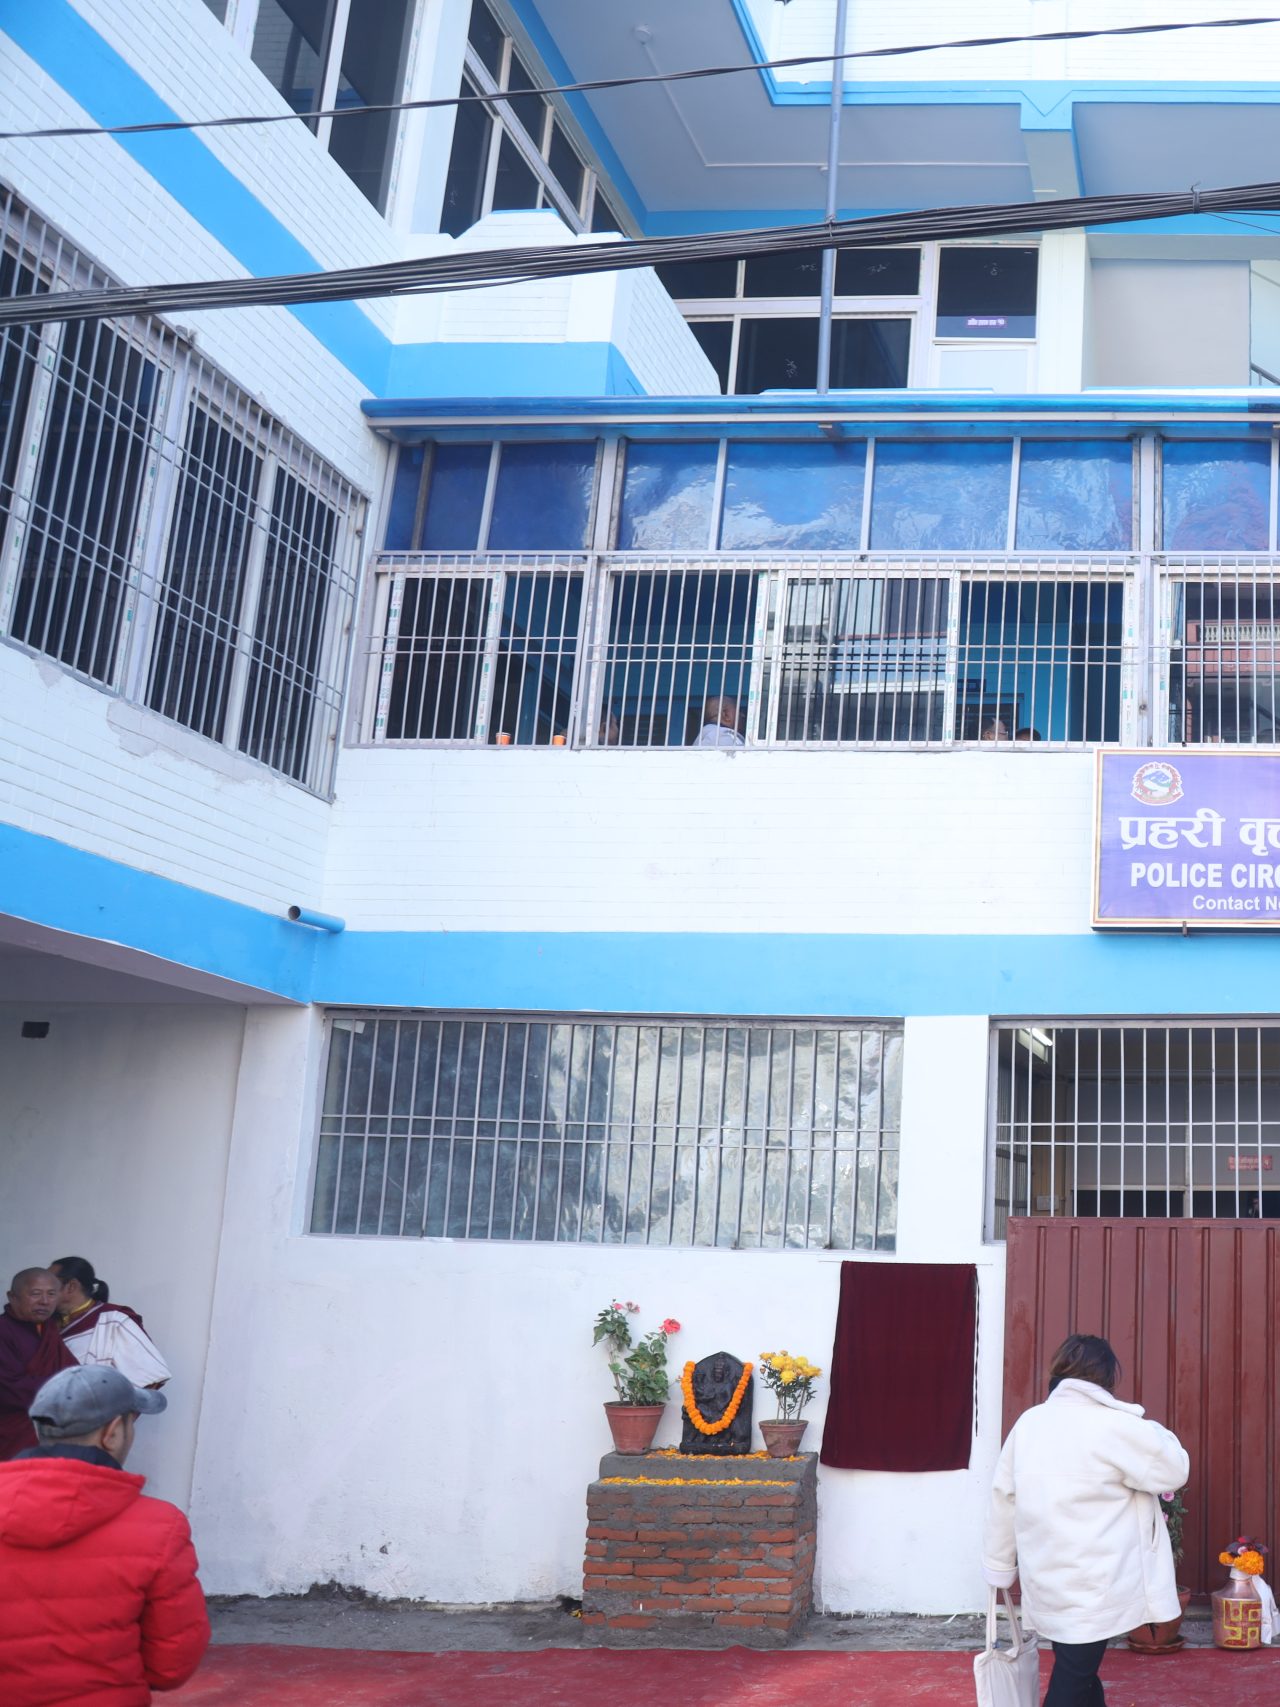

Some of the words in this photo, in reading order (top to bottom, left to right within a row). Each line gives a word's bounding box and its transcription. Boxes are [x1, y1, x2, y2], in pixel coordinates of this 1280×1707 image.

[1118, 807, 1226, 850] प्रहरी
[1130, 862, 1223, 888] POLICE
[1192, 895, 1260, 911] Contact
